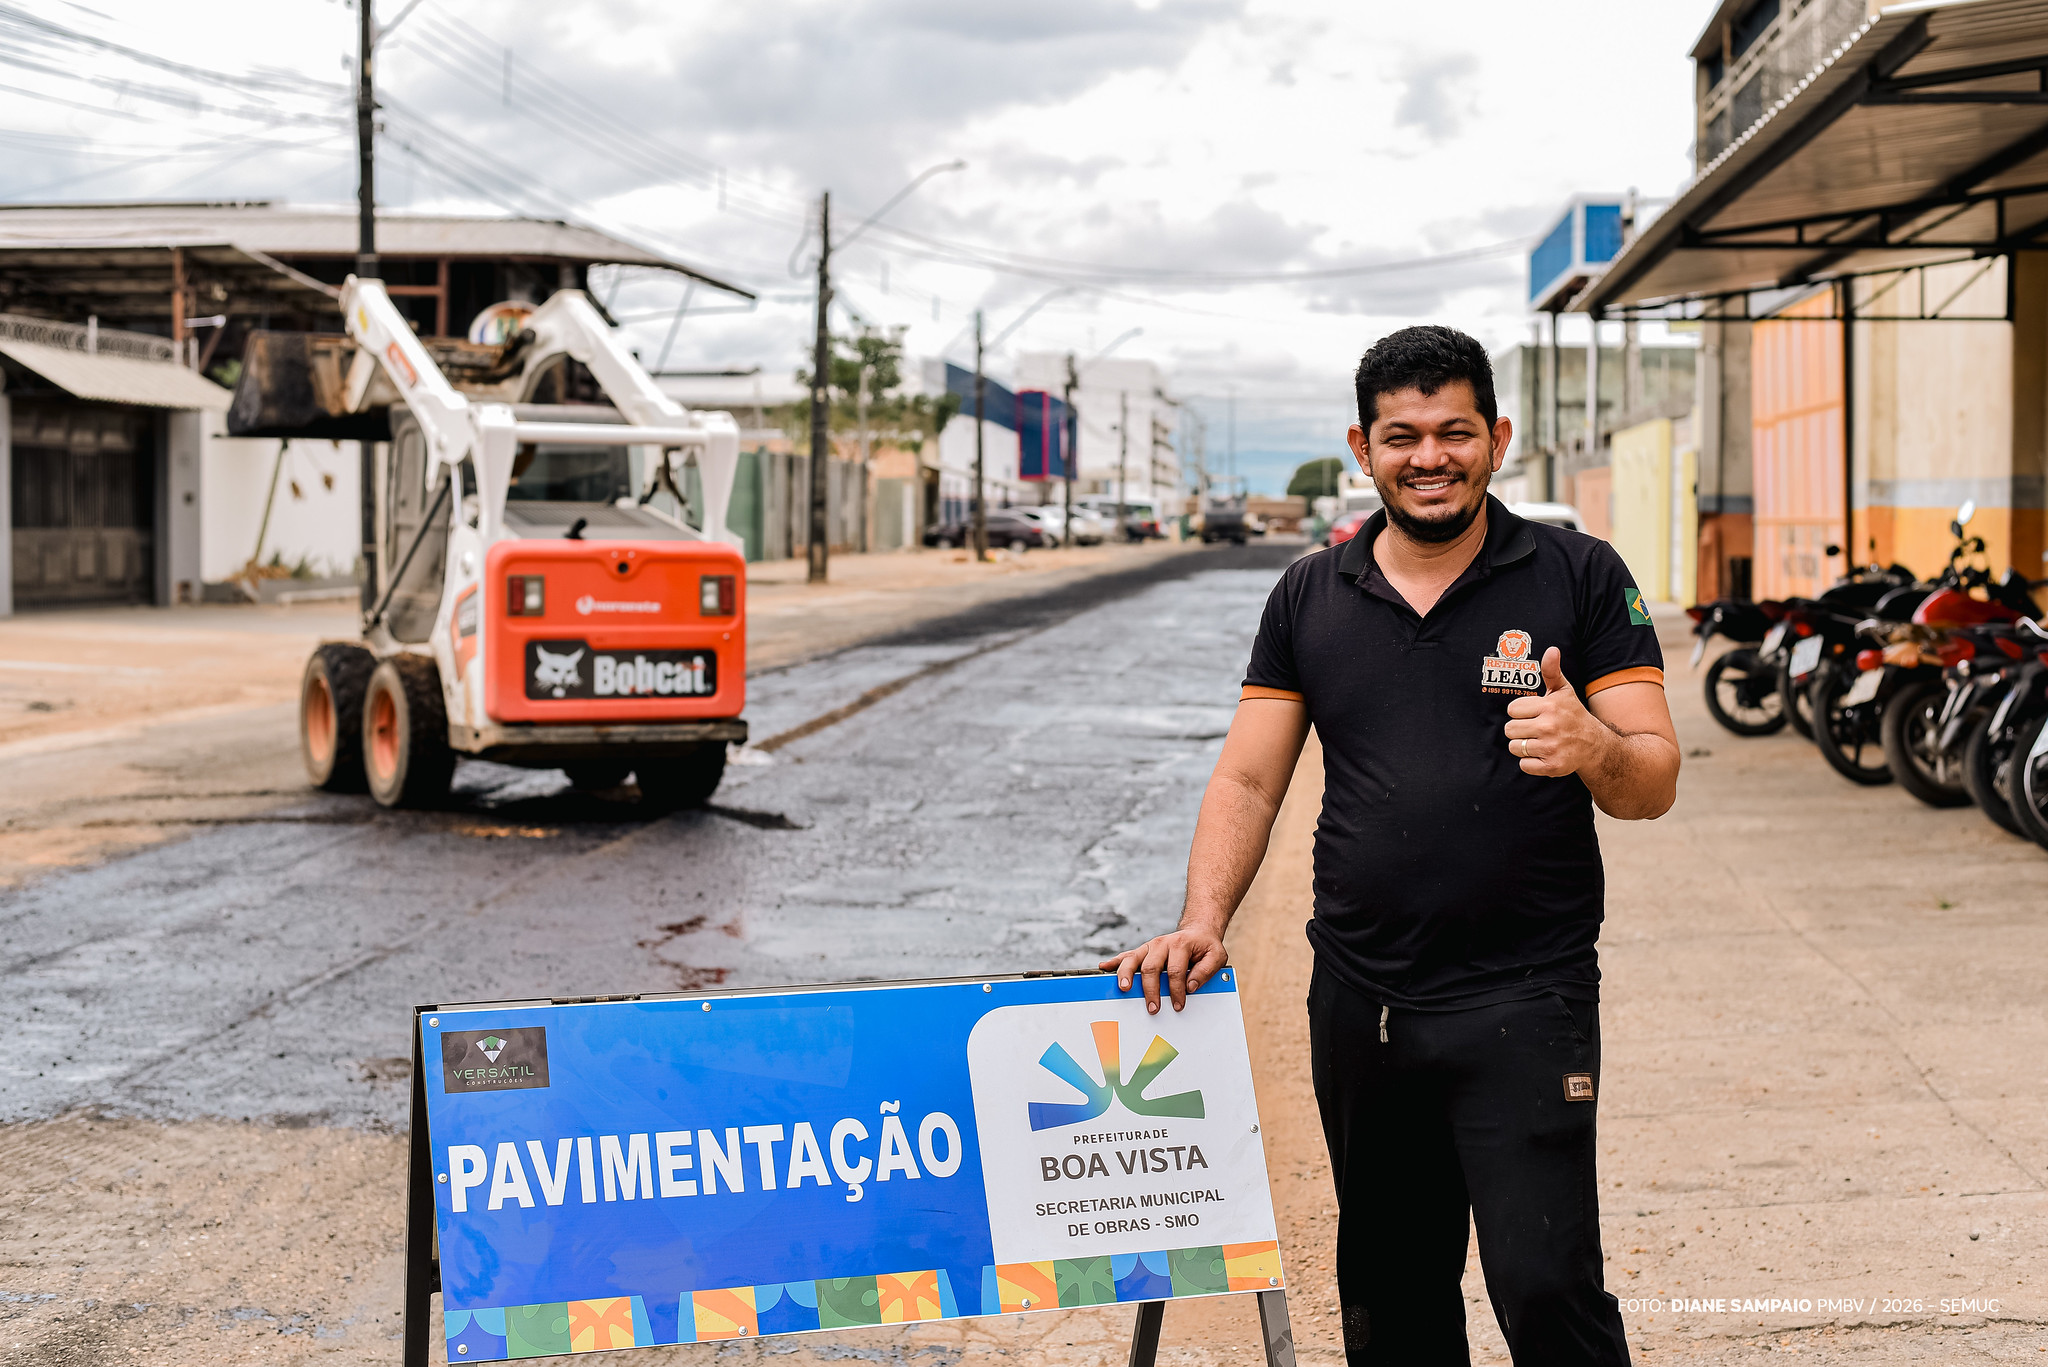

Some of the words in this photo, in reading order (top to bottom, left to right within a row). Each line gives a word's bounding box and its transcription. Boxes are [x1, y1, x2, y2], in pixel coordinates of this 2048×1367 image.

[593, 655, 707, 695] Bobcat
[1486, 659, 1537, 671] RETIFICA
[1486, 669, 1538, 687] LEÃO
[453, 1065, 535, 1080] VERSÁTIL
[447, 1100, 963, 1213] PAVIMENTAÇÃO
[1040, 1152, 1111, 1182] BOA
[1115, 1145, 1209, 1175] VISTA
[1035, 1196, 1137, 1217] SECRETARIA
[1140, 1188, 1225, 1208] MUNICIPAL
[1068, 1223, 1091, 1237] DE
[1094, 1217, 1151, 1235] OBRAS
[1164, 1213, 1200, 1229] SMO
